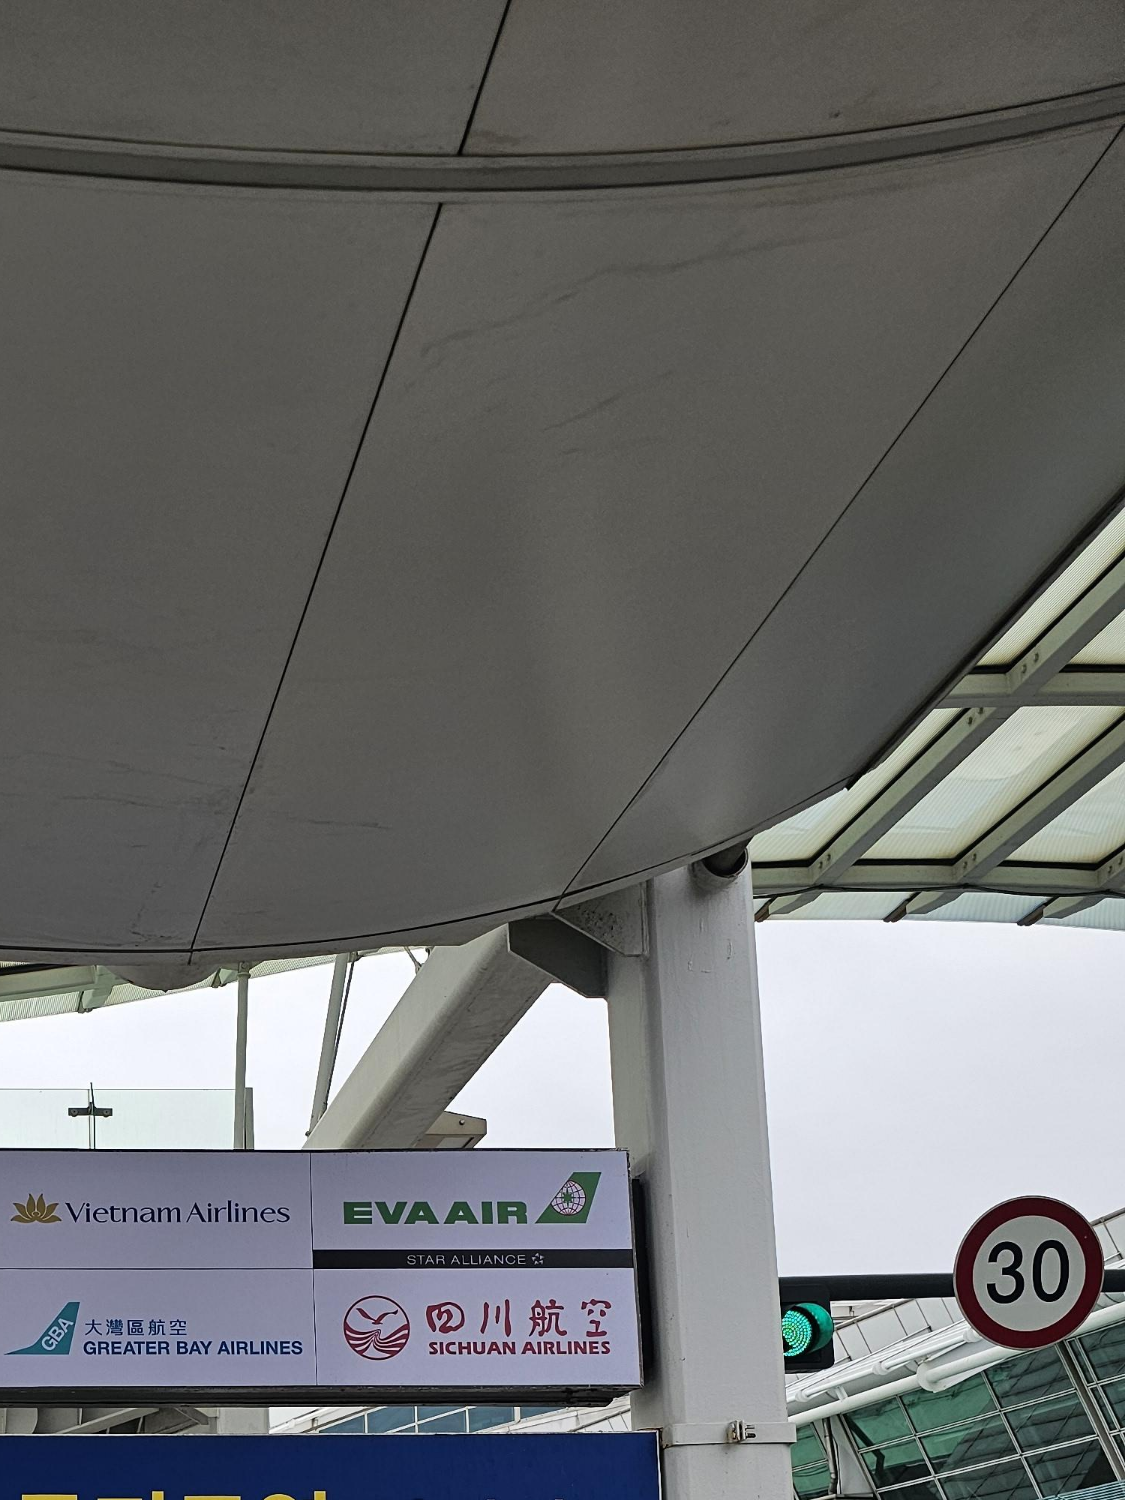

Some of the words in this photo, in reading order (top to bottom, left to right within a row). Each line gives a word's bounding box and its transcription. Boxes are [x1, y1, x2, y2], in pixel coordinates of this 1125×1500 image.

[65, 1201, 182, 1224] Vietnam
[186, 1200, 291, 1224] Airlines
[407, 1254, 446, 1265] STAR
[451, 1254, 526, 1265] ALLIANCE
[986, 1239, 1070, 1304] 30
[84, 1318, 188, 1337] 大灣區航空
[426, 1298, 613, 1338] 四川航空
[41, 1316, 75, 1351] GBA
[83, 1340, 171, 1356] GREATER
[176, 1340, 213, 1356] BAY
[217, 1340, 303, 1355] AIRLINES
[428, 1340, 516, 1355] SICHUAN
[520, 1340, 612, 1355] AIRLINES
